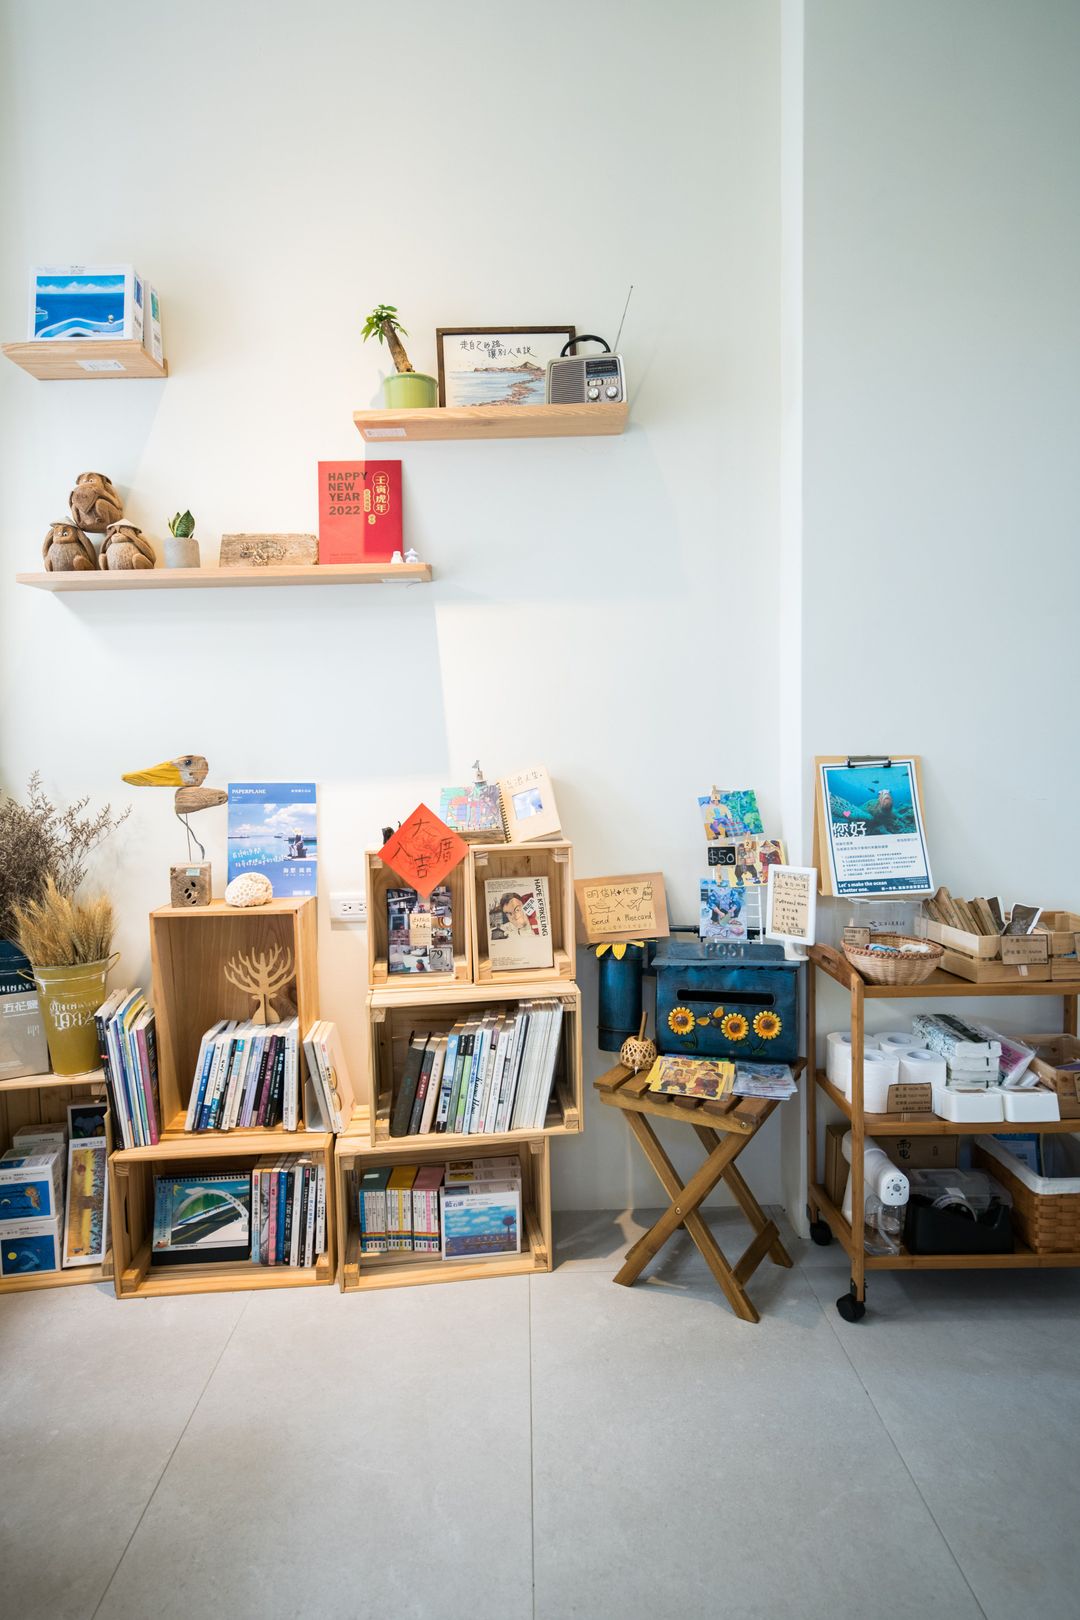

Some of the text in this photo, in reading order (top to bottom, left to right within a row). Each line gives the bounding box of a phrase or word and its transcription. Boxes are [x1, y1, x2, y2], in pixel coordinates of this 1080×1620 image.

[460, 340, 504, 352] 走自己的路
[328, 472, 368, 481] HAPPY
[328, 482, 355, 491] NEW
[329, 492, 360, 502] YEAR
[329, 505, 361, 515] 2022
[833, 821, 867, 838] 您好
[709, 848, 735, 864] $50
[534, 878, 549, 937] HAPE KERKELING
[591, 915, 609, 926] Send
[431, 950, 443, 959] 79
